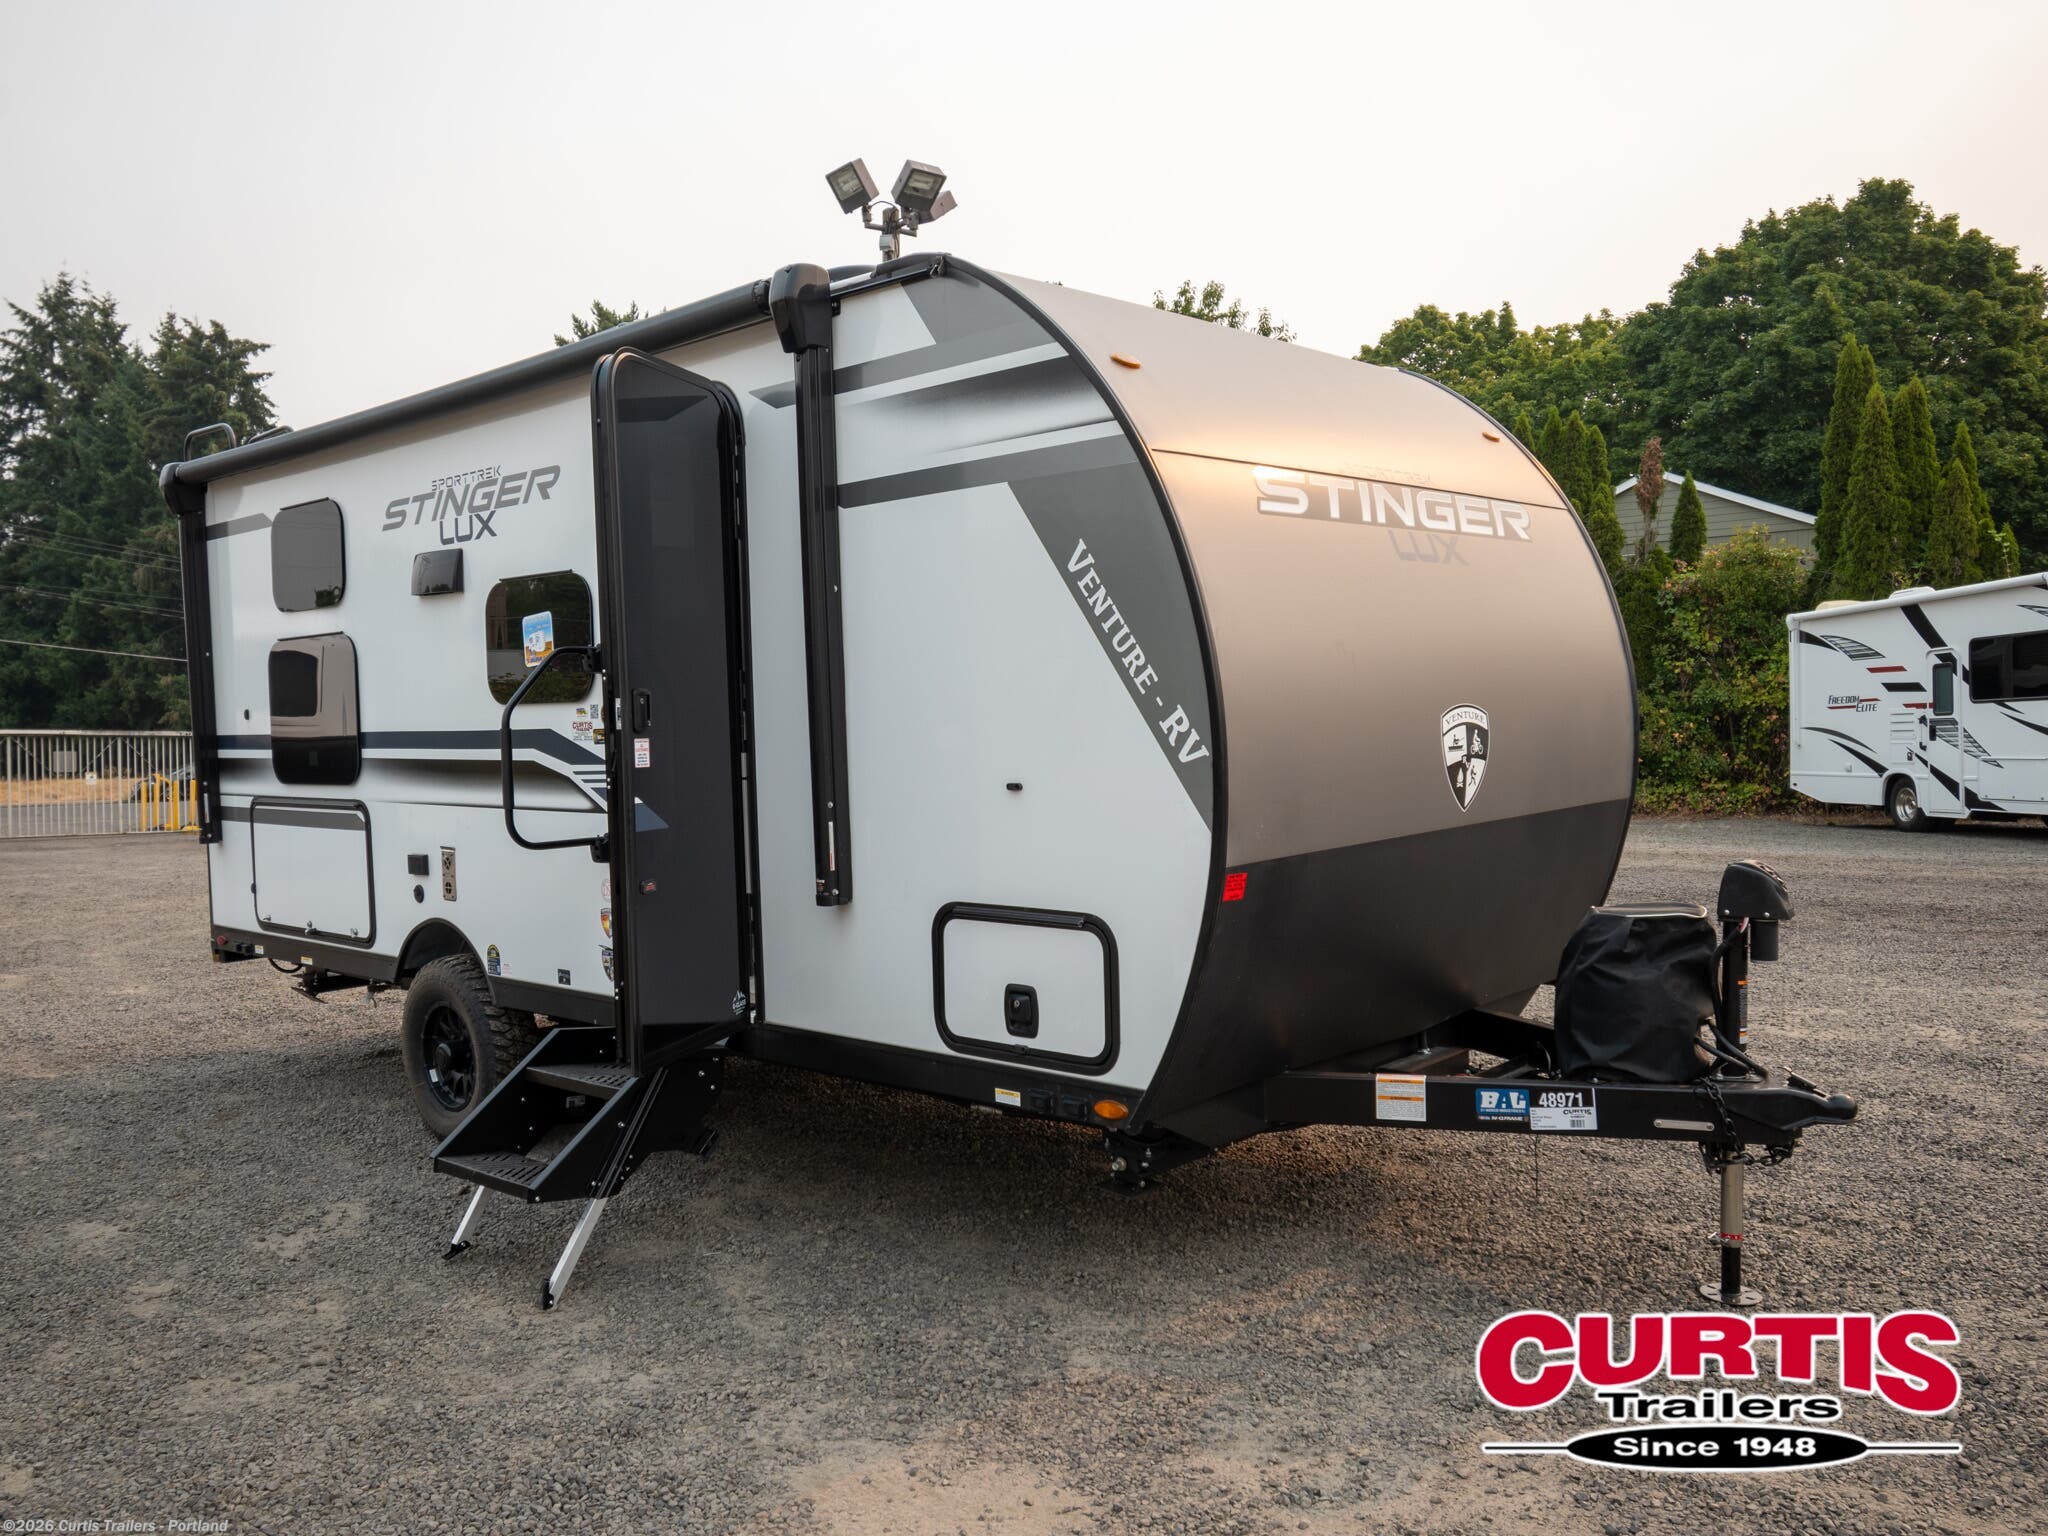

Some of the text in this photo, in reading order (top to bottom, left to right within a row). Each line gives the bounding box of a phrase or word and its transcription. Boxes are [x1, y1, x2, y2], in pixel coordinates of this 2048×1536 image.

[432, 465, 501, 491] SPORTTREK
[383, 465, 561, 532] STINGER
[1252, 465, 1532, 541] STINGER
[440, 510, 498, 545] LUX
[1387, 529, 1470, 566] LUX
[1066, 538, 1159, 695] VENTURE
[1159, 704, 1209, 763] RV
[1827, 695, 1860, 705] FREEDOM
[1855, 703, 1878, 713] ELITE
[1445, 710, 1485, 725] VENTURE
[1538, 1092, 1583, 1108] 48971
